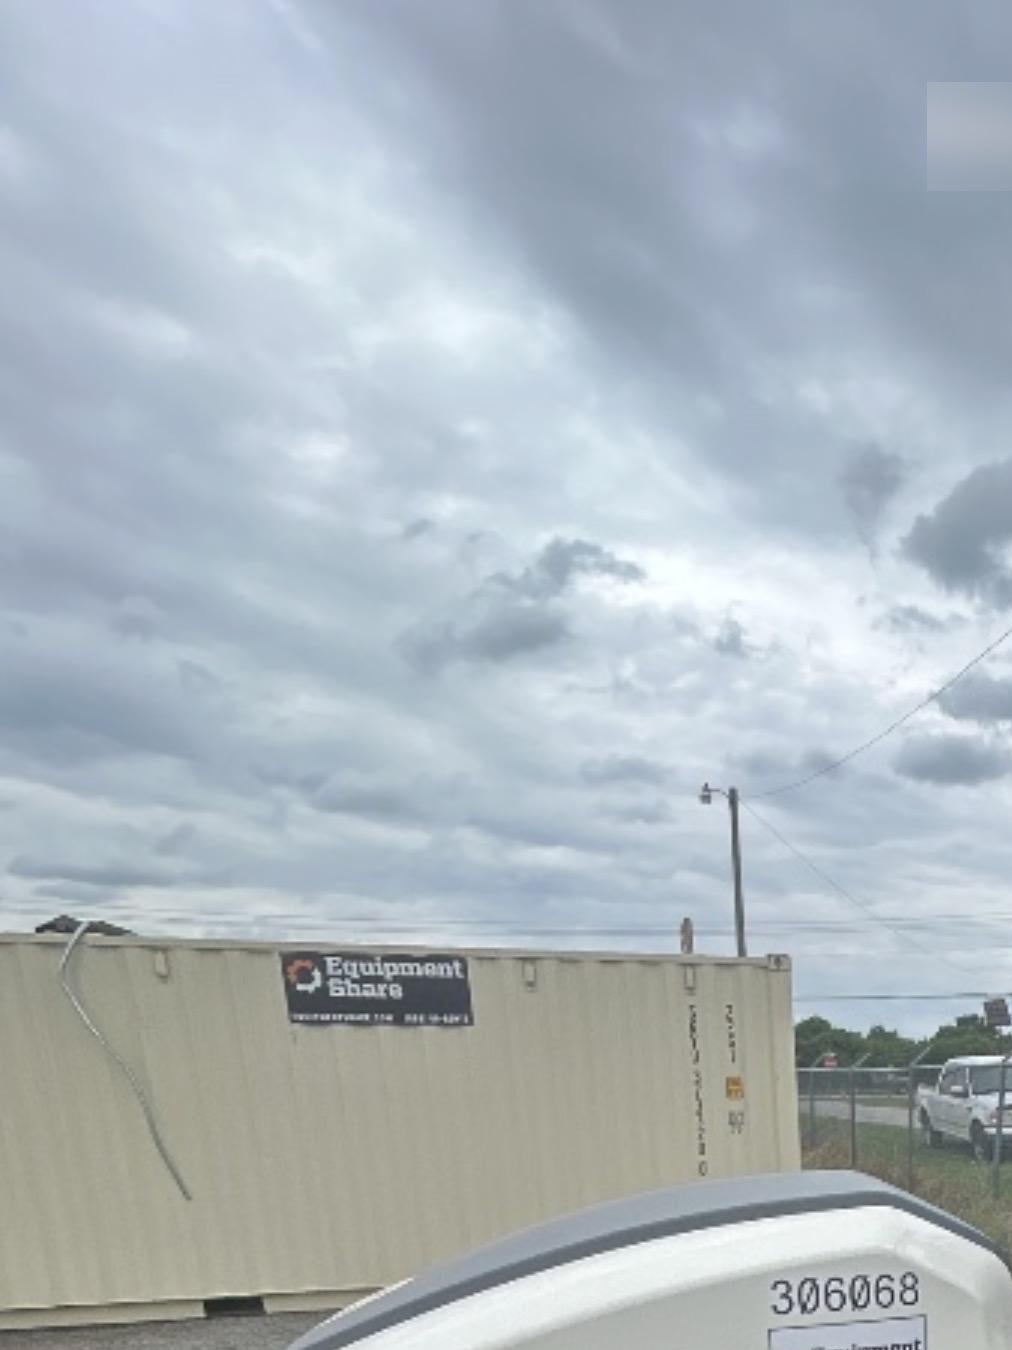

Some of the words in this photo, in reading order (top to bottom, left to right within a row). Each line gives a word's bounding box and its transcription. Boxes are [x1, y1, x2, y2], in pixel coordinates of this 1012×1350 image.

[325, 956, 464, 979] Equipment
[329, 978, 403, 998] Share
[770, 1272, 919, 1314] 306068
